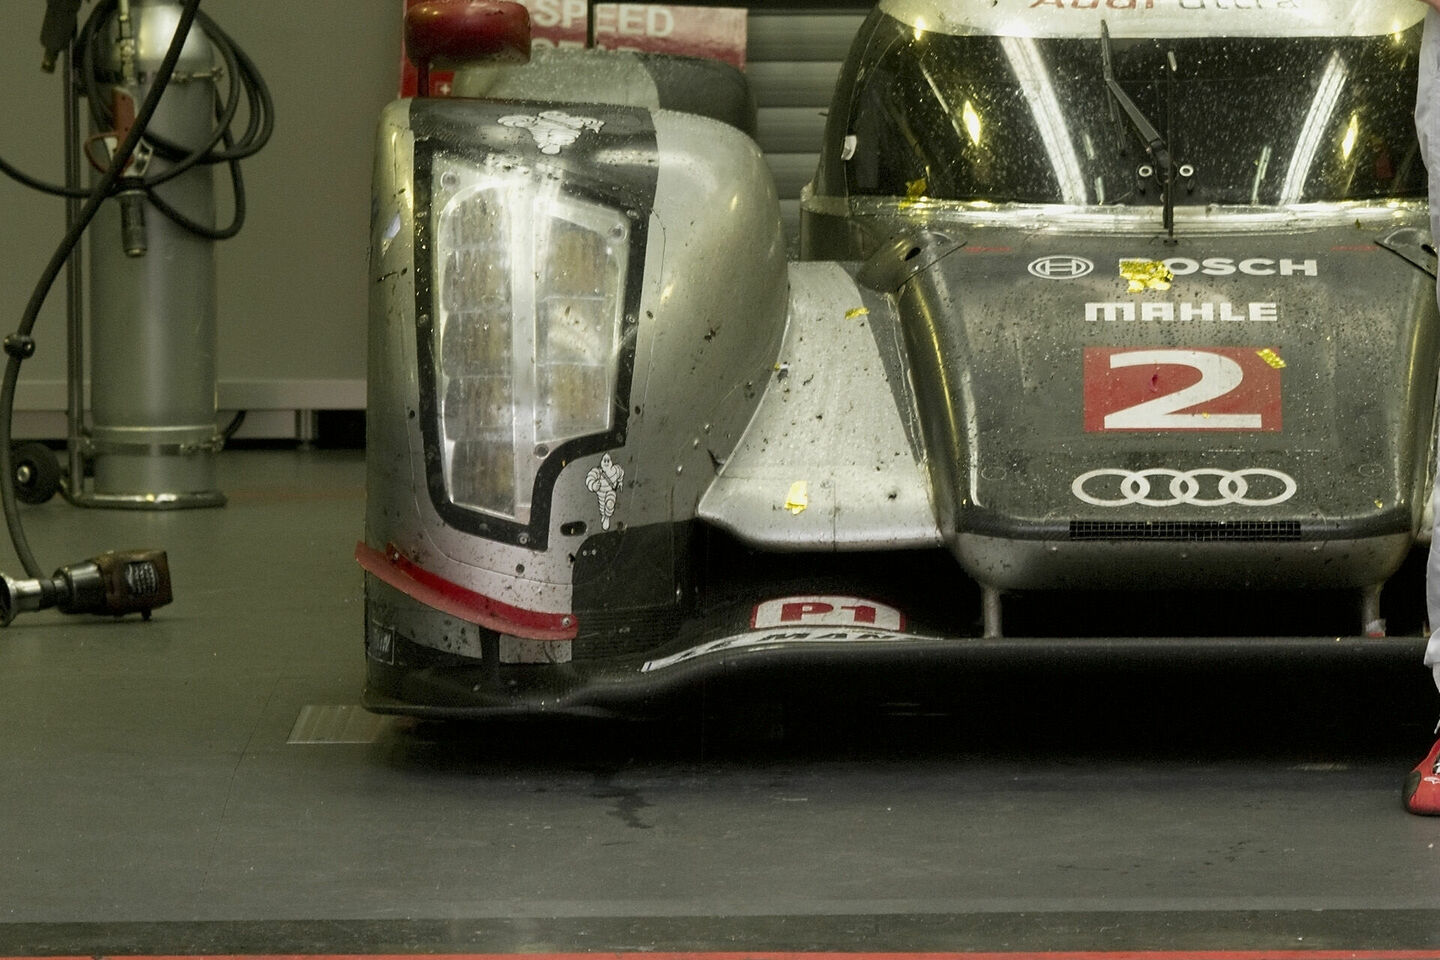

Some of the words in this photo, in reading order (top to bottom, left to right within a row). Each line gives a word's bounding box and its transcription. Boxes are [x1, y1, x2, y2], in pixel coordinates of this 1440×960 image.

[1085, 302, 1278, 321] MAHLE
[1104, 350, 1262, 428] 2
[781, 601, 876, 624] P1
